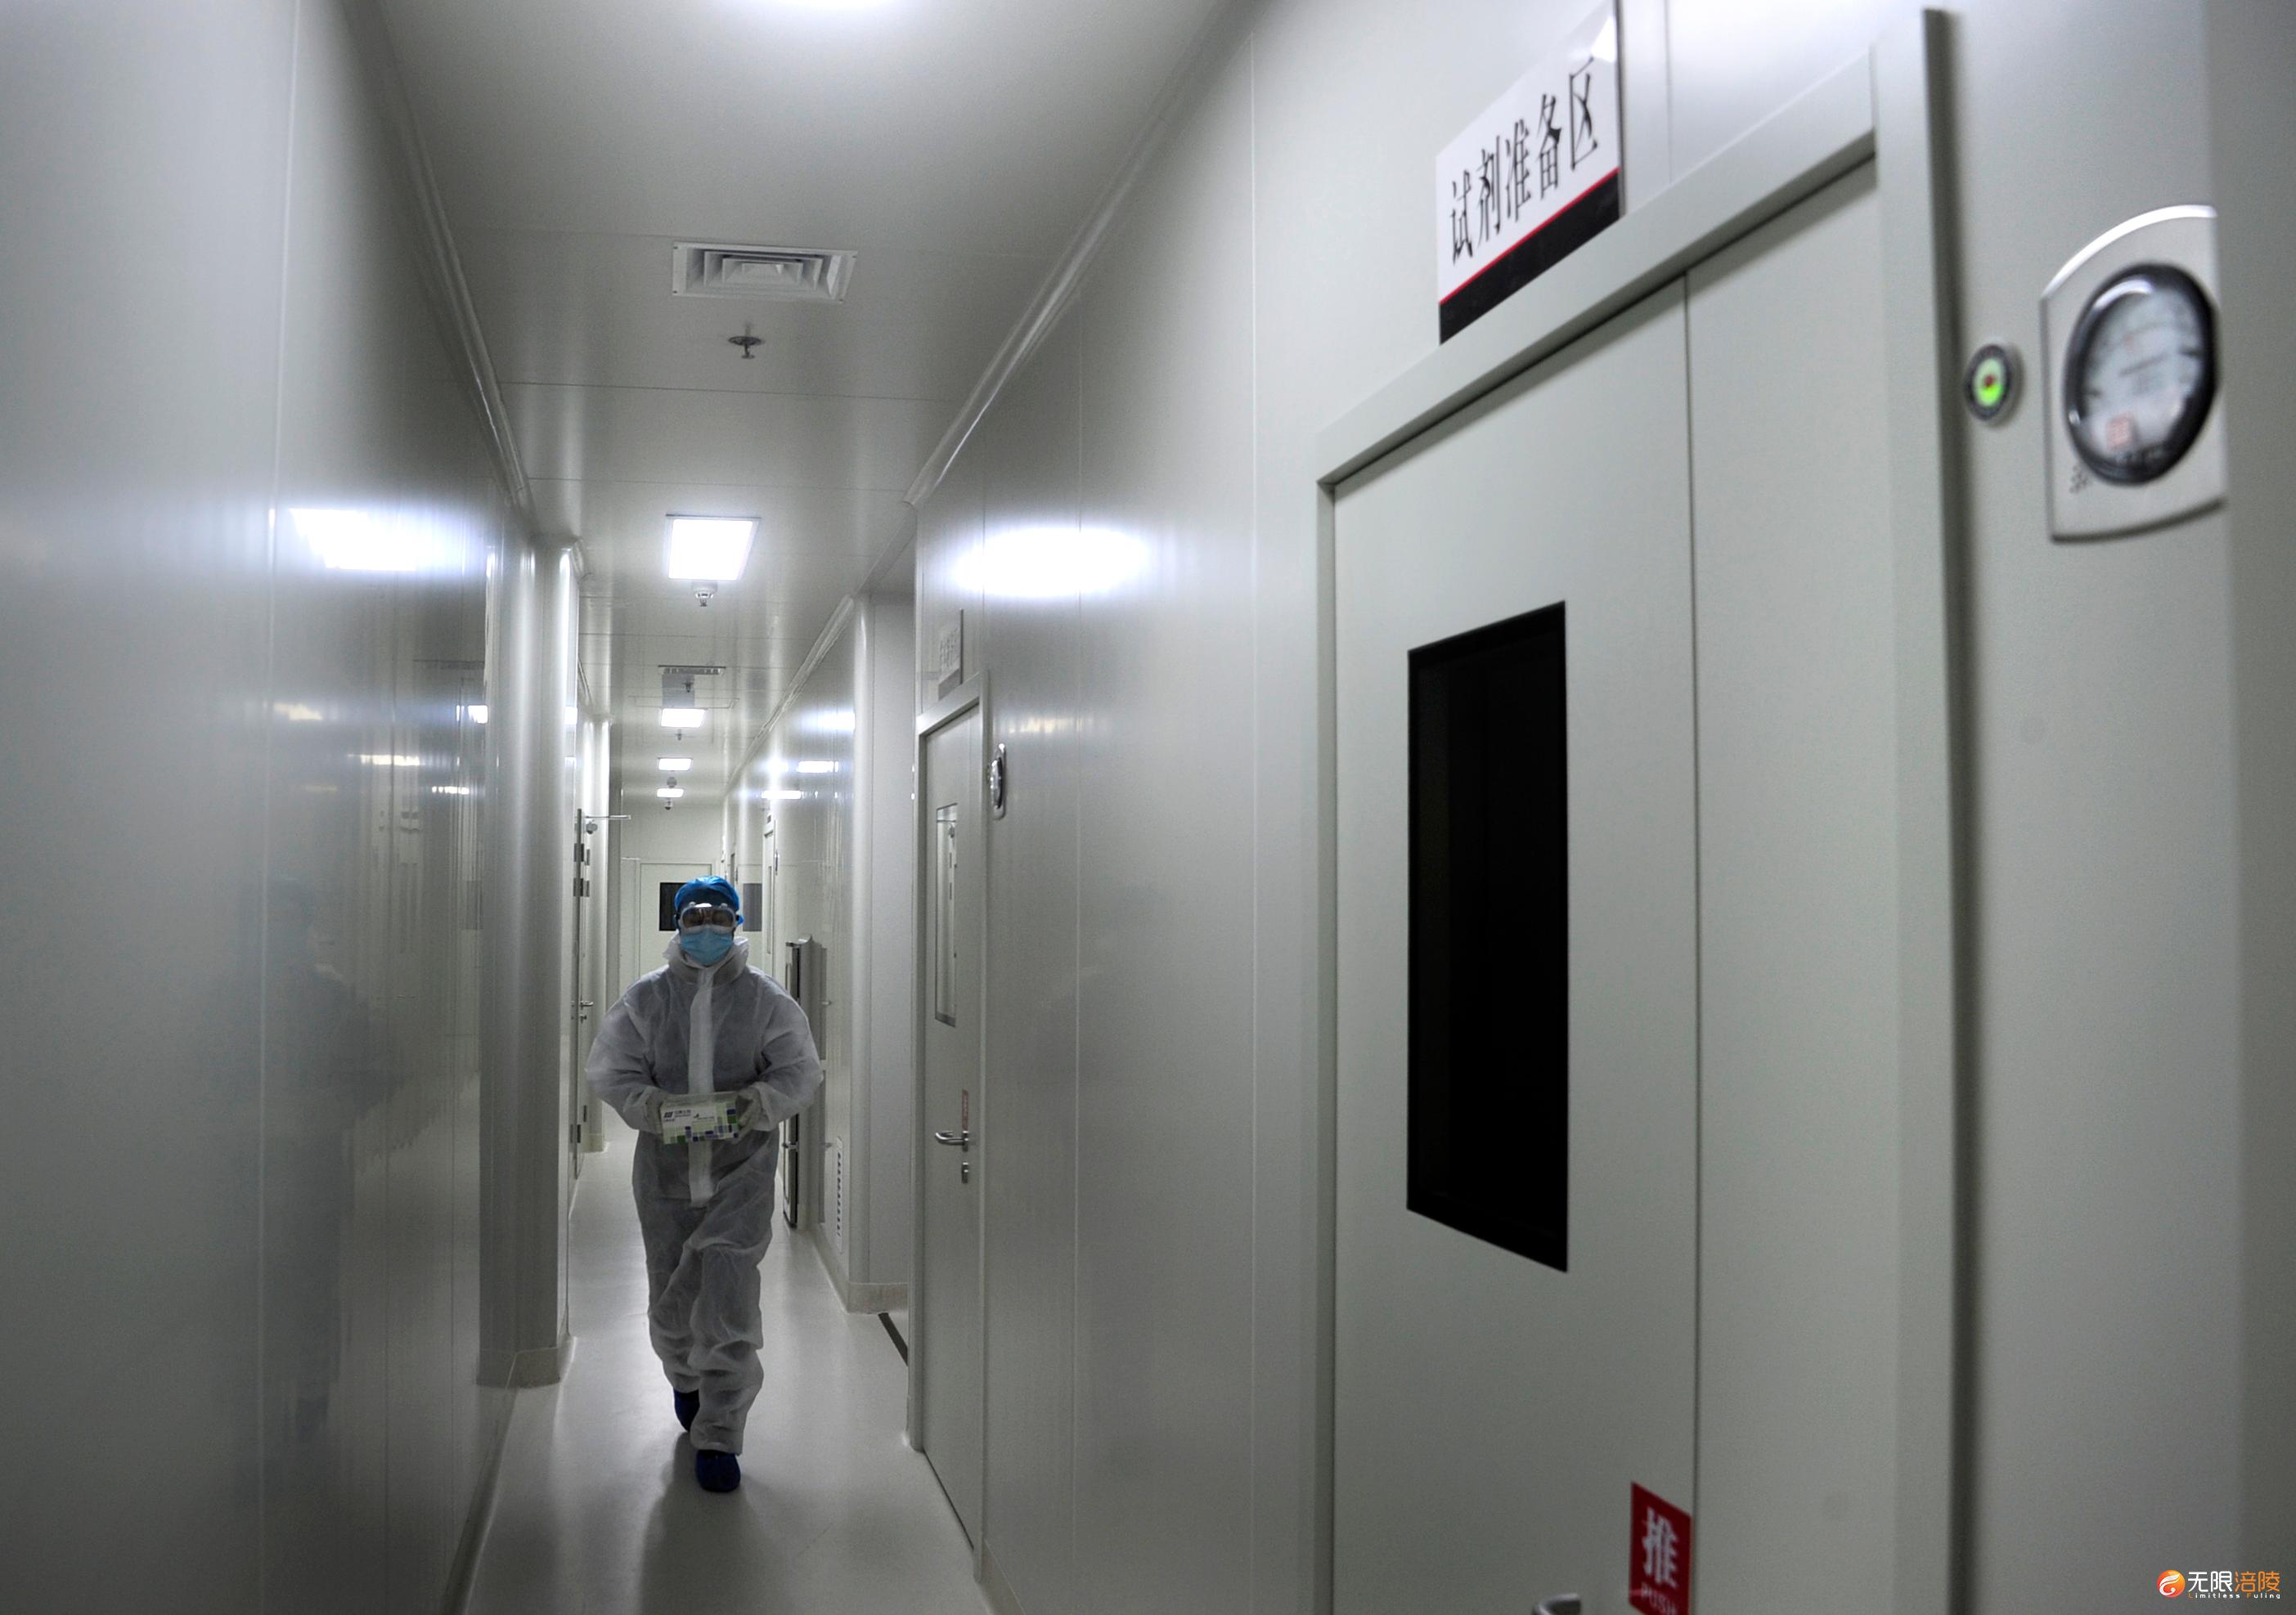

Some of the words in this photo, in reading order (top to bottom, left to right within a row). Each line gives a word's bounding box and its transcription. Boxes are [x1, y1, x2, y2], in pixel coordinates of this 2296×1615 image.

[1449, 56, 1598, 267] 试剂准备区
[1641, 1505, 1678, 1590] 推
